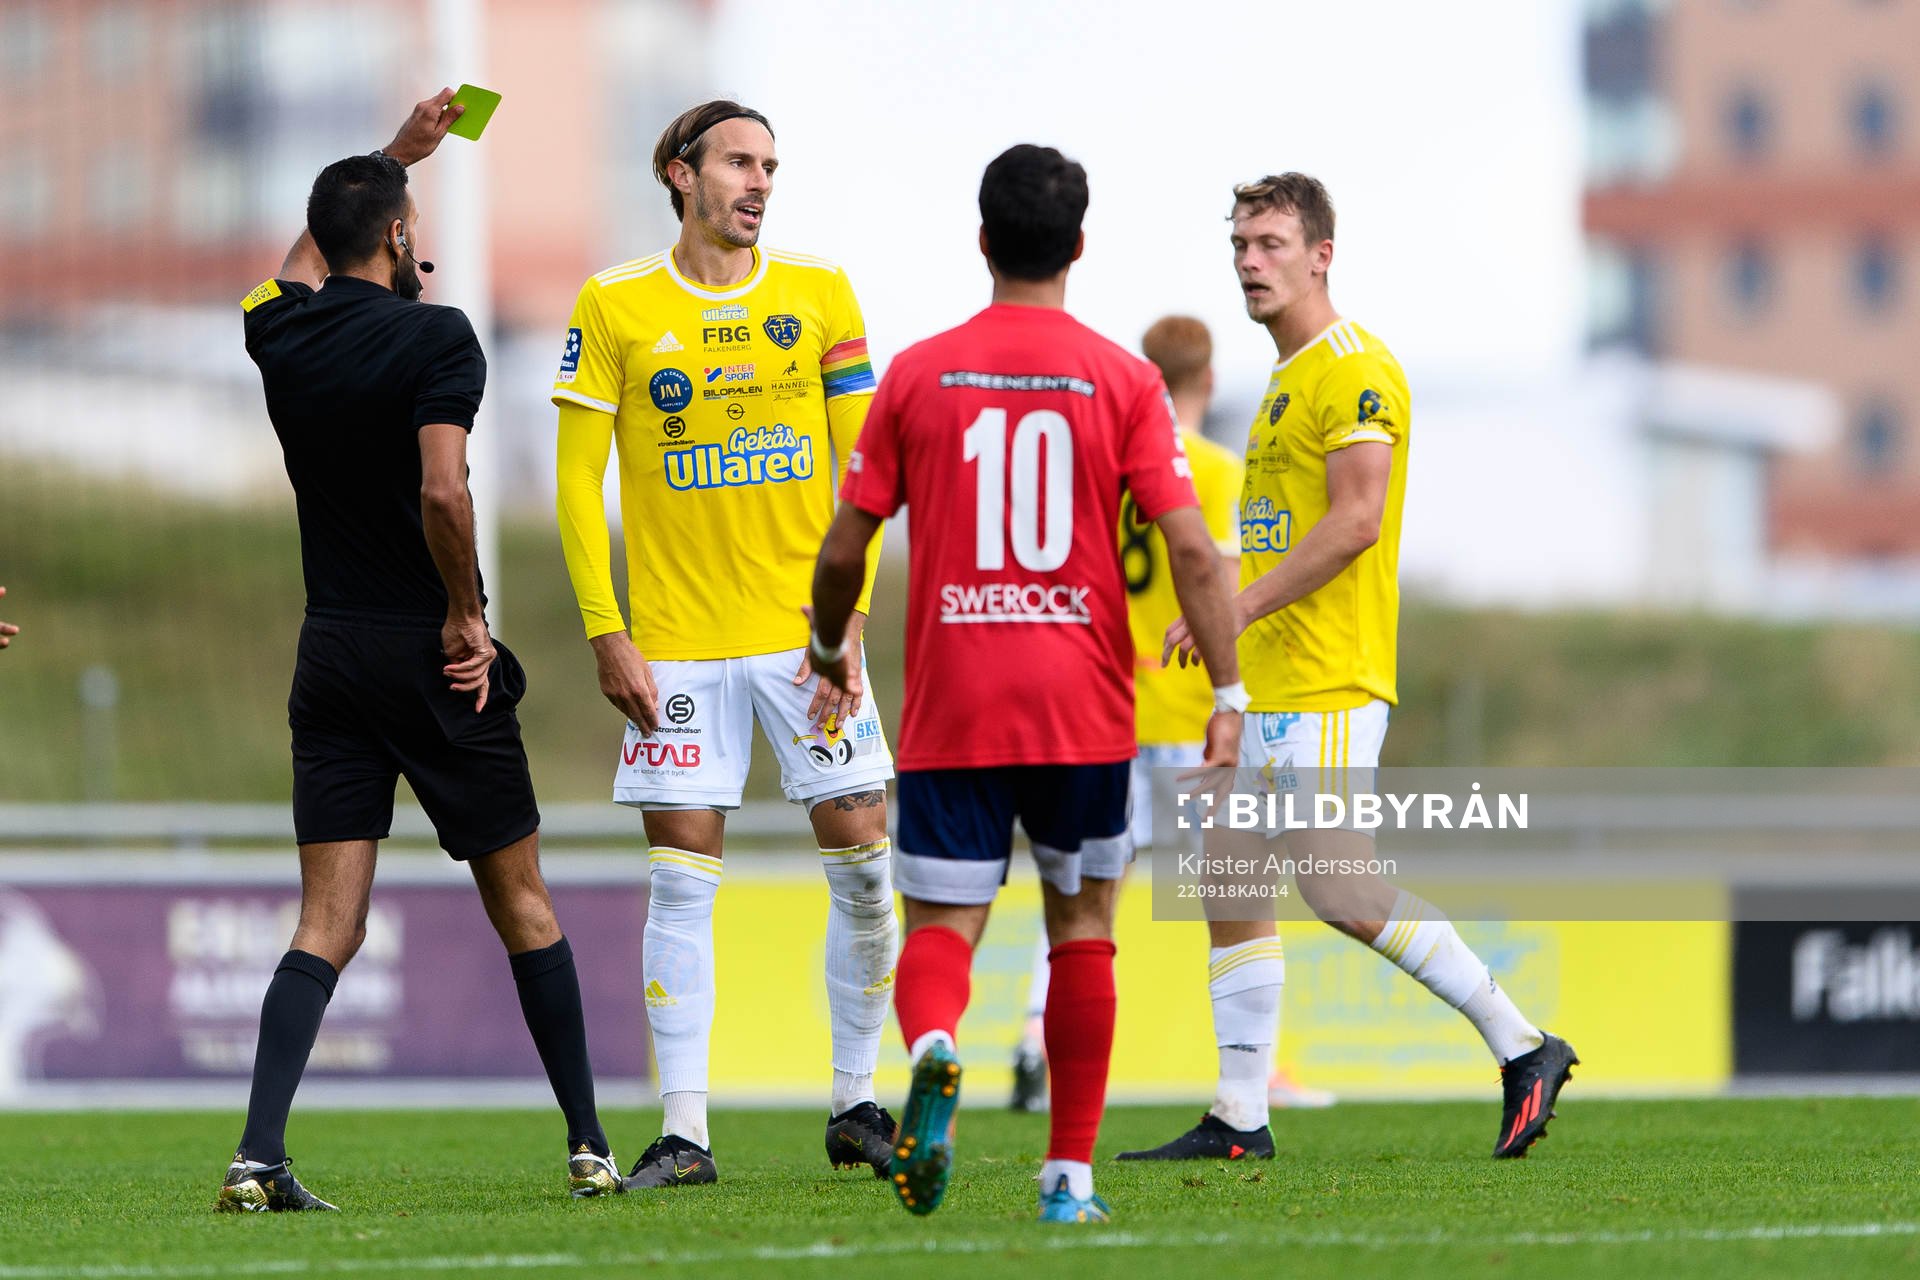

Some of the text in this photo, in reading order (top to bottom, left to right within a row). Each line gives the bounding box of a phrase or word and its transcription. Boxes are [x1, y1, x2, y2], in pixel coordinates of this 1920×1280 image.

[702, 307, 748, 321] Ullared
[703, 326, 751, 344] FBG
[703, 344, 752, 353] FALKENBERG
[724, 364, 755, 373] INTER
[724, 371, 755, 382] SPORT
[660, 383, 682, 400] JM
[703, 386, 763, 397] BILOPALEN
[728, 424, 797, 453] Gekås
[664, 436, 814, 490] Ullared
[963, 407, 1075, 573] 10
[940, 584, 1092, 615] SWEROCK
